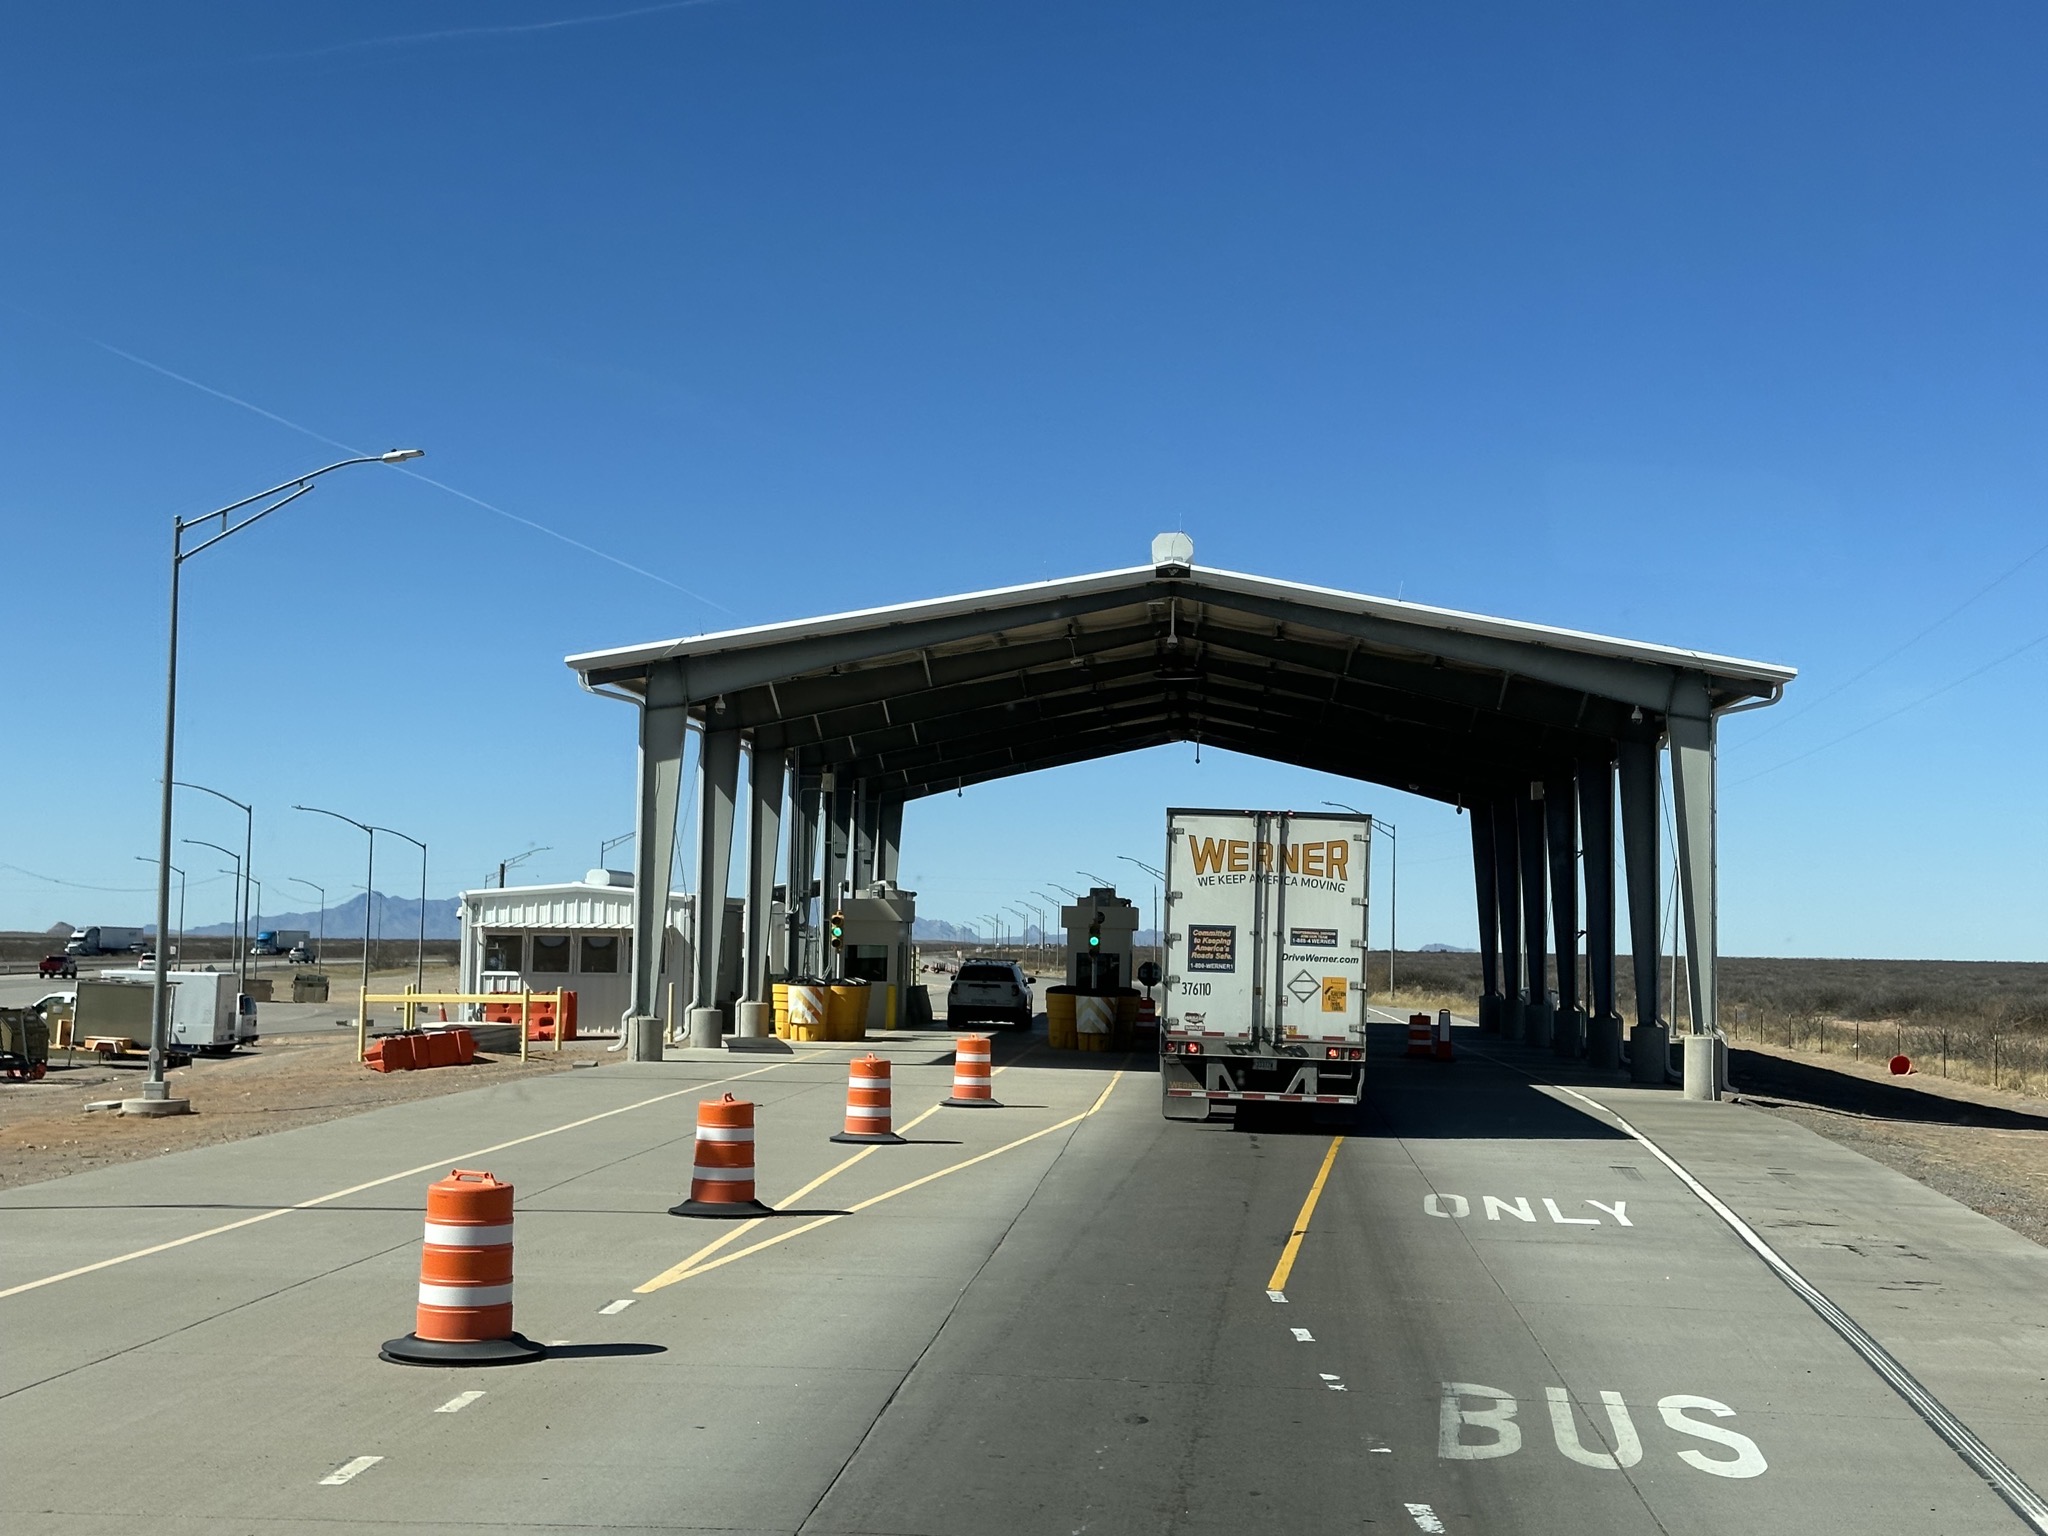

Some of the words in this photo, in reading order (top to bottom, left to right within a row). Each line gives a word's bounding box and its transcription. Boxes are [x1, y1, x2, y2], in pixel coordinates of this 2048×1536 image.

[1188, 834, 1348, 881] WERNER
[1197, 875, 1215, 887] WE
[1218, 874, 1246, 885] KEEP
[1249, 874, 1298, 887] AMERICA
[1300, 877, 1346, 893] MOVING
[1192, 929, 1231, 937] Committed
[1194, 944, 1230, 952] America's
[1202, 937, 1231, 946] Keeping
[1281, 953, 1359, 964] DriveWerner.com
[1181, 982, 1211, 996] 376110
[1423, 1193, 1634, 1226] ONLY
[1438, 1381, 1768, 1478] BUS
